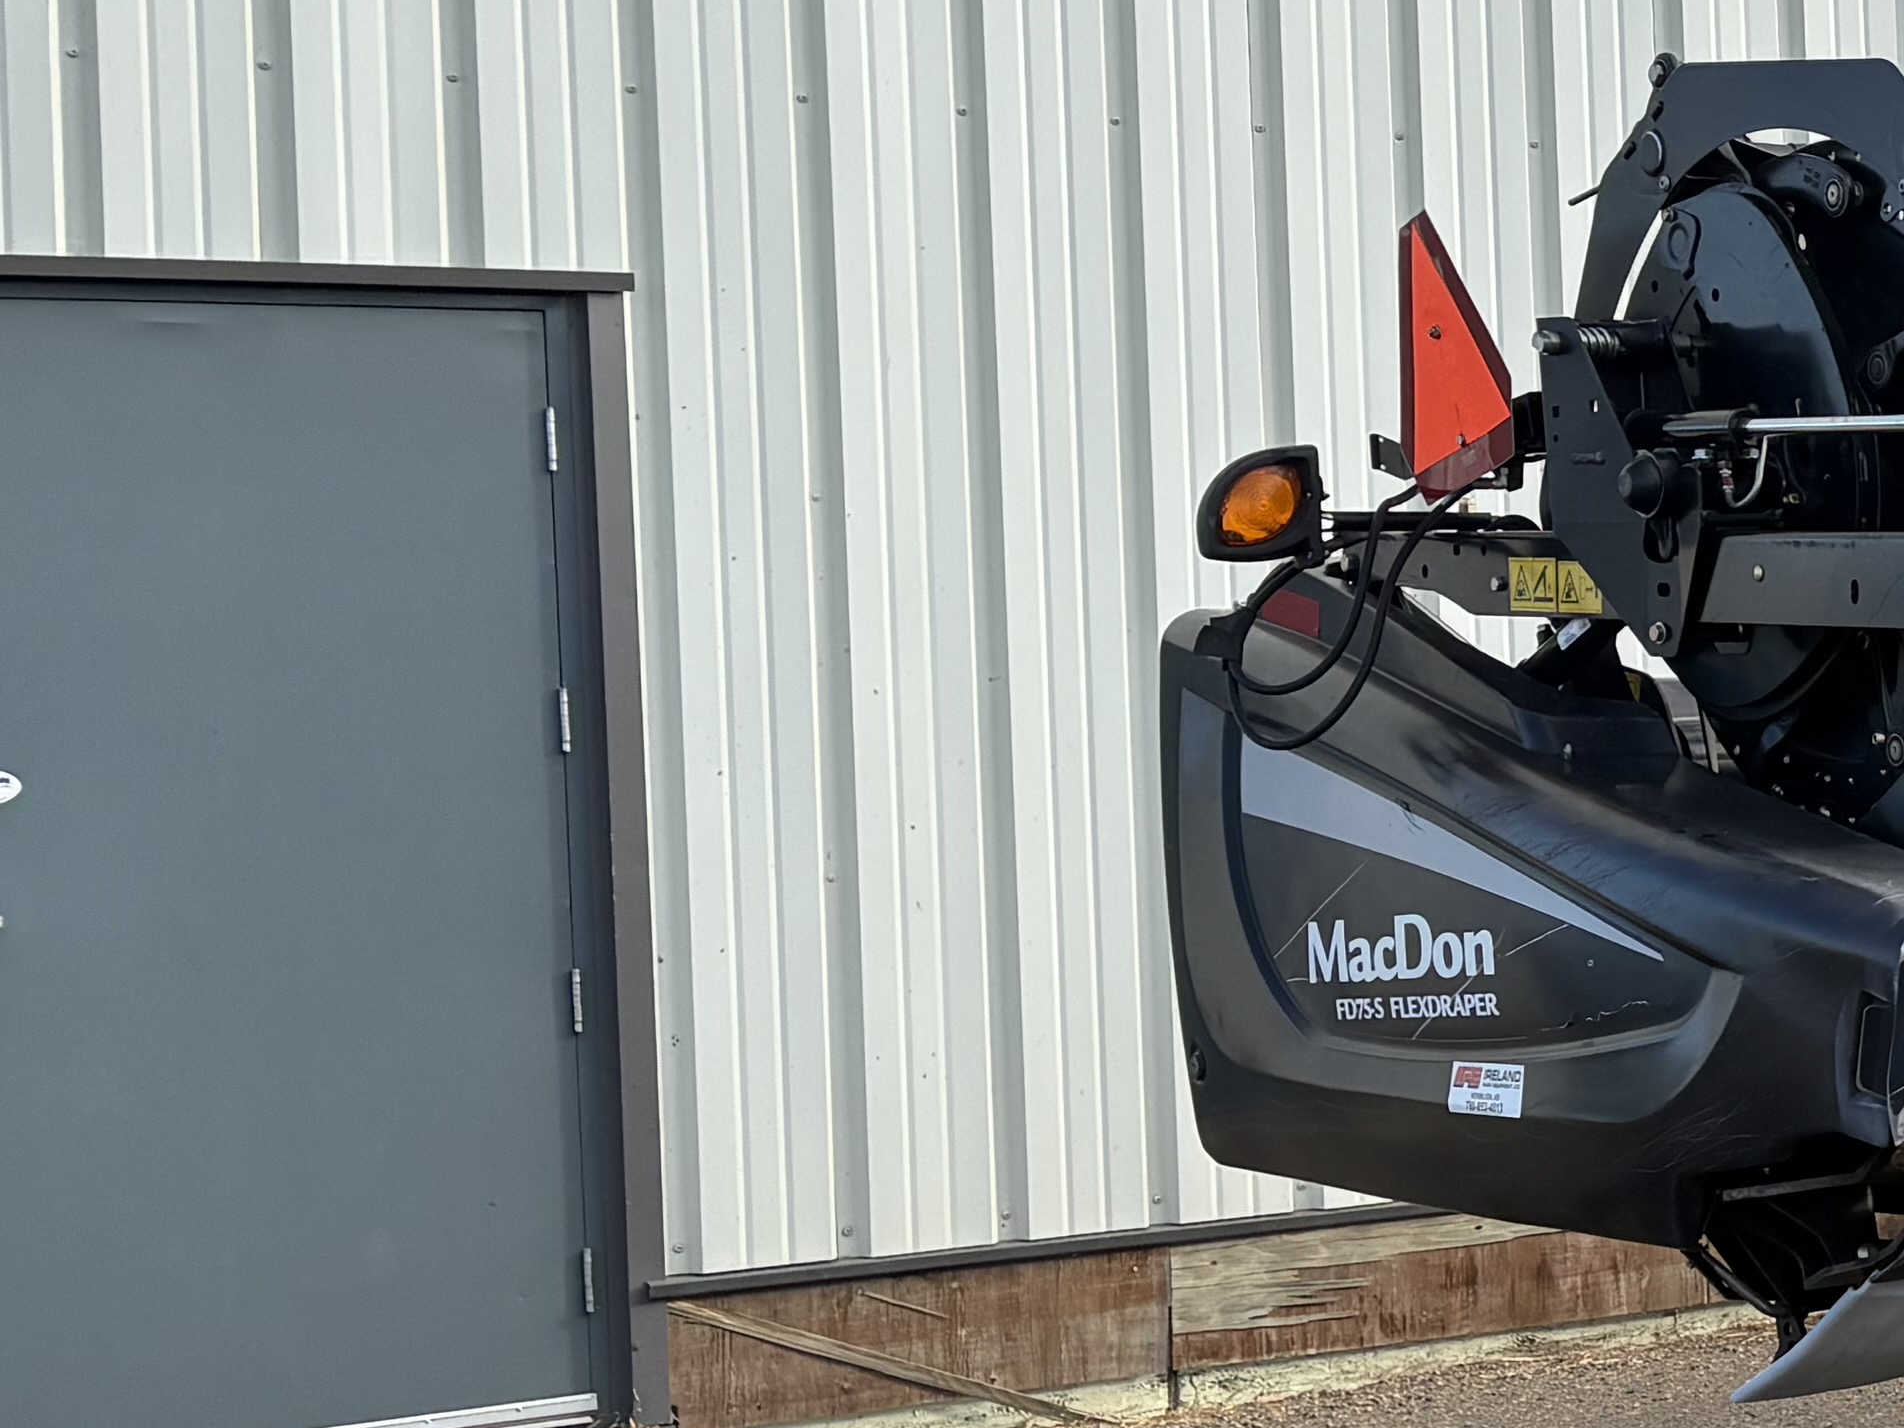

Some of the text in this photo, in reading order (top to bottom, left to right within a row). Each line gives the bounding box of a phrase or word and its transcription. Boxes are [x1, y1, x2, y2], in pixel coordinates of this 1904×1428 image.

[1307, 913, 1496, 984] MacDon
[1335, 992, 1501, 1021] FD75-S FLEXDRAPER
[1483, 1069, 1522, 1083] IRELAND
